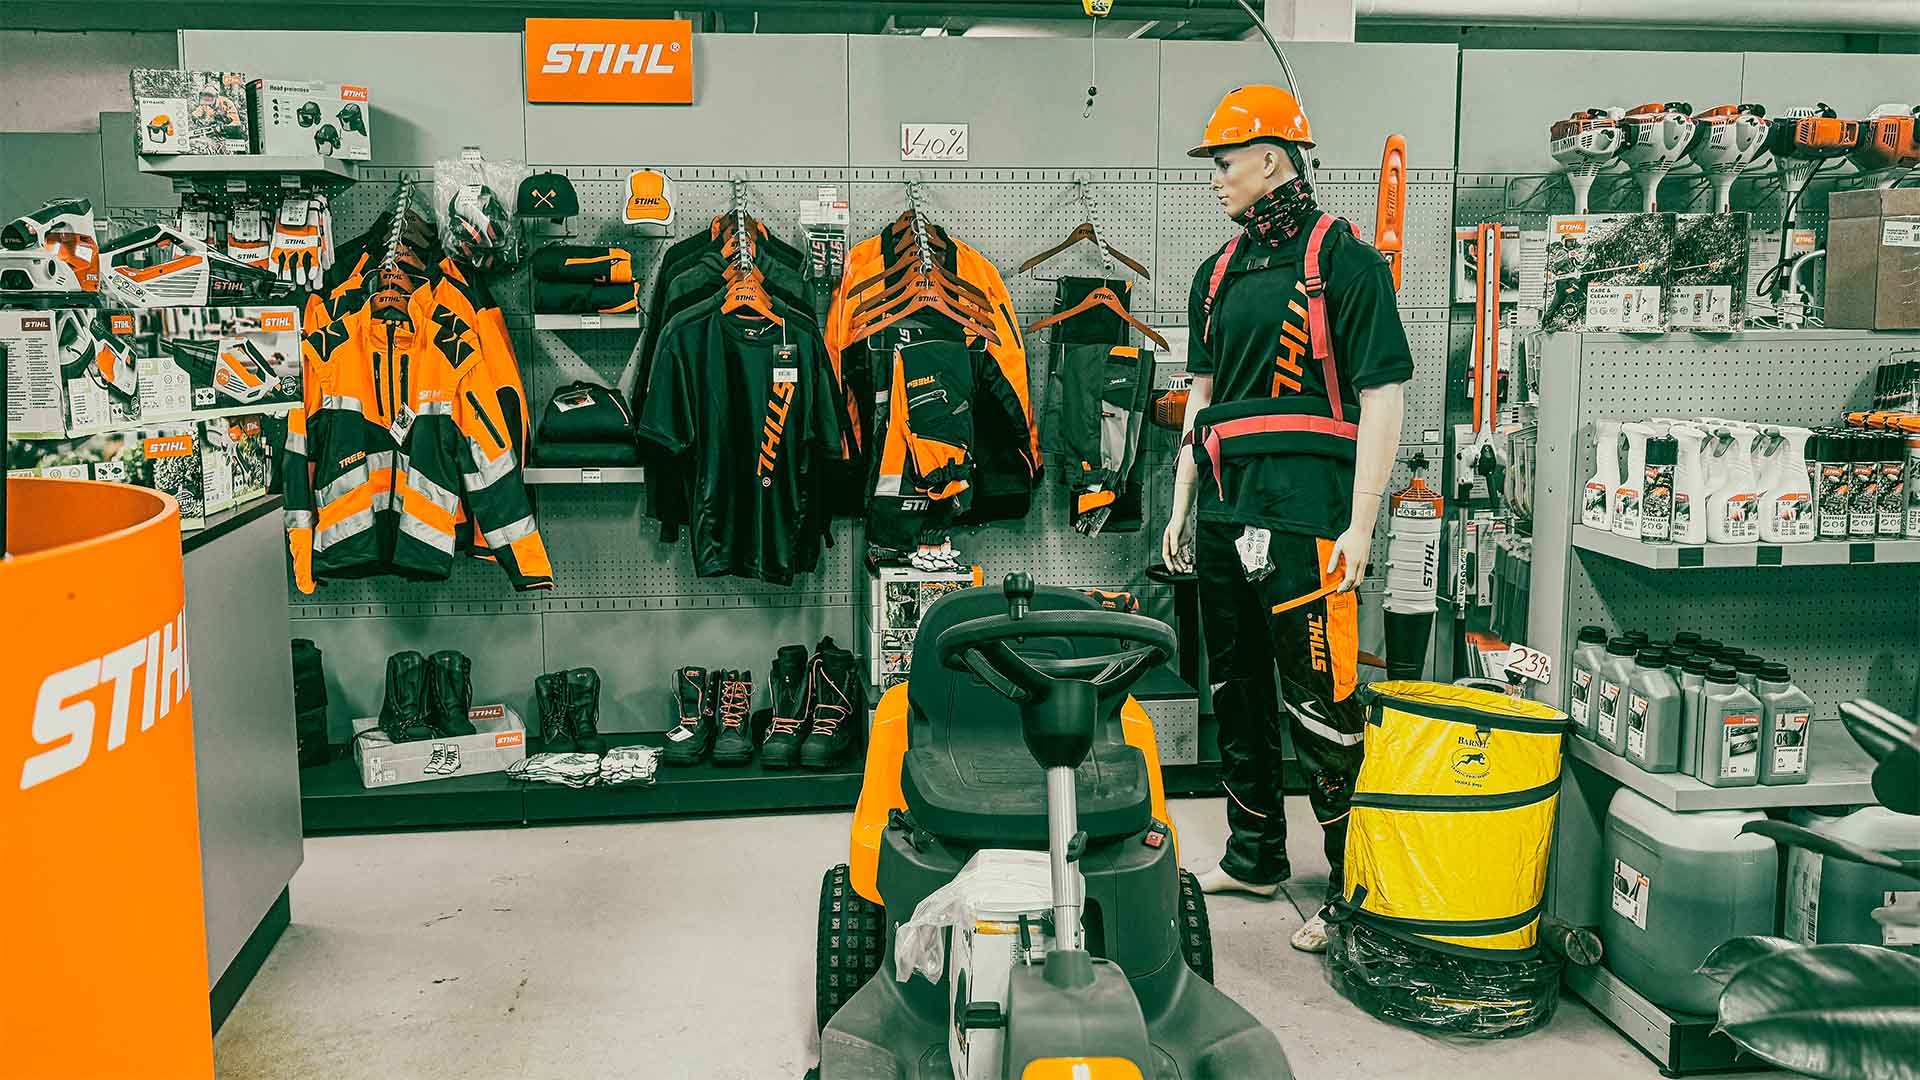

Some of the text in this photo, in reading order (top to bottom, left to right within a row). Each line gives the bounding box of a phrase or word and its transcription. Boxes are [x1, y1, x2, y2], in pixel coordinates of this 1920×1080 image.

[541, 42, 675, 75] STIHL
[343, 89, 366, 98] STIHL
[912, 127, 965, 156] 40%
[635, 197, 660, 205] STIHL
[1079, 228, 1096, 236] STIH
[1559, 223, 1584, 231] STIHL
[213, 281, 246, 292] STIHL
[113, 320, 131, 328] STIHL
[264, 317, 291, 327] STIHL
[1271, 280, 1310, 398] TIHL
[757, 381, 795, 477] STIHL
[149, 441, 188, 453] STIHL
[901, 499, 930, 511] STI
[1424, 540, 1437, 589] STIHL
[1308, 615, 1328, 673] STIHL
[496, 735, 521, 744] STIHL
